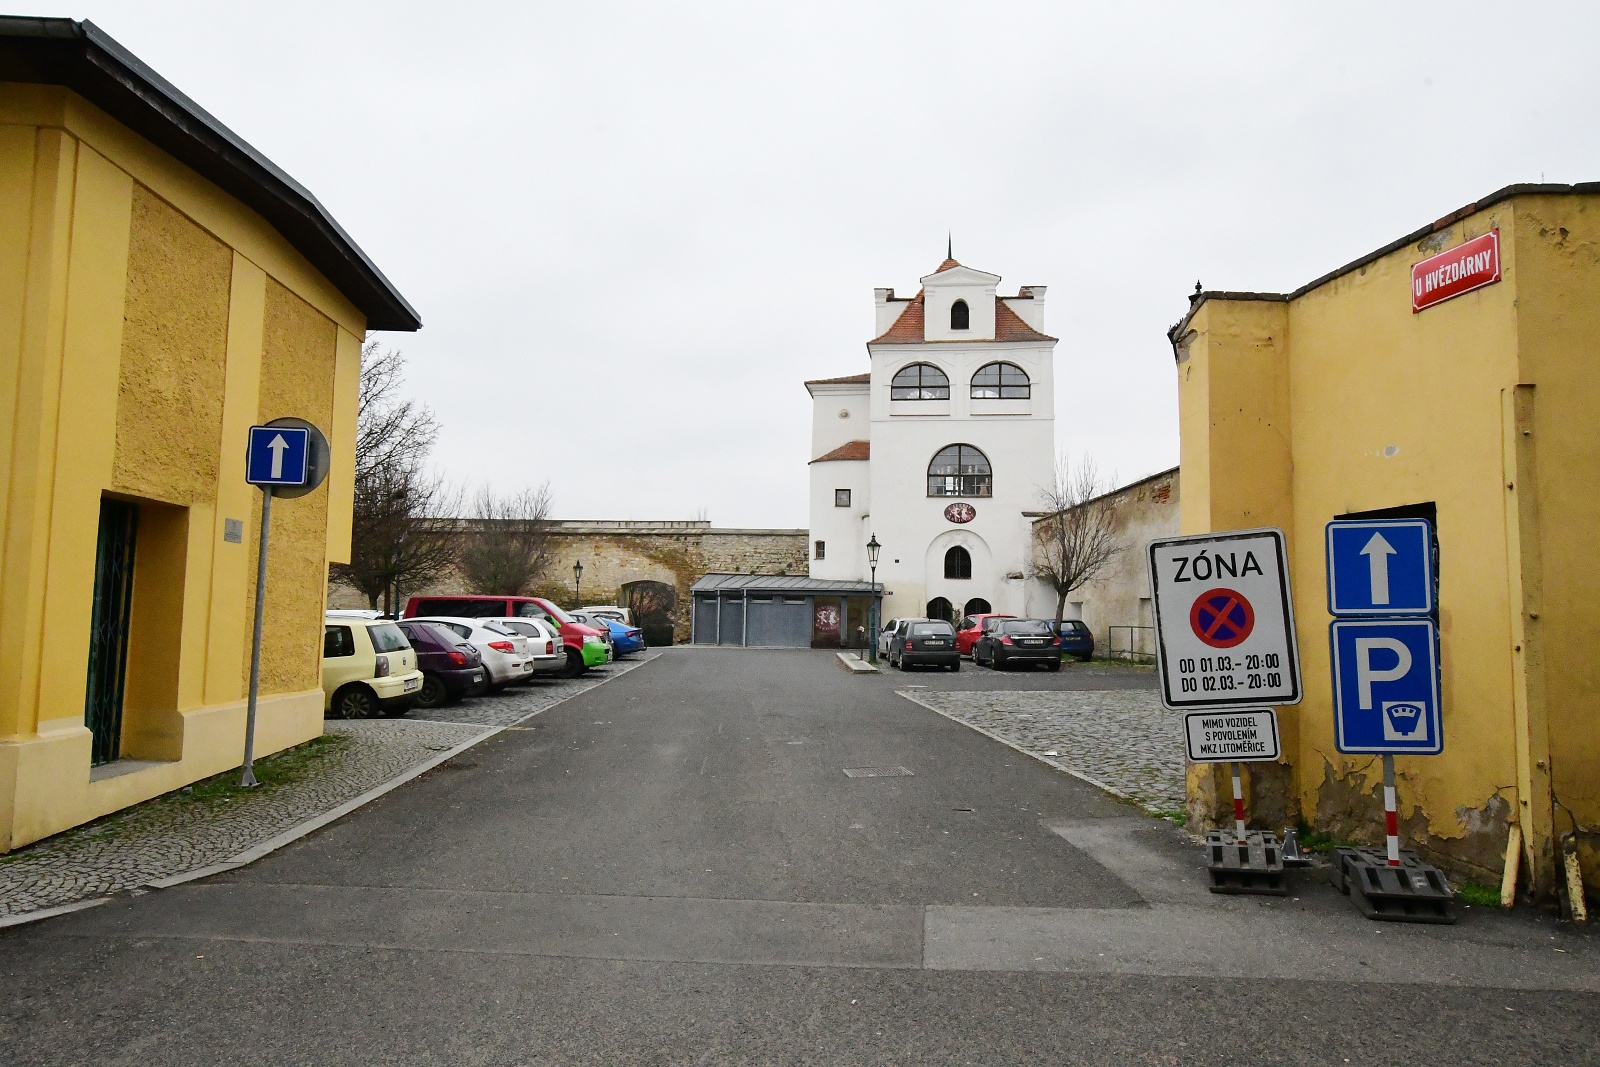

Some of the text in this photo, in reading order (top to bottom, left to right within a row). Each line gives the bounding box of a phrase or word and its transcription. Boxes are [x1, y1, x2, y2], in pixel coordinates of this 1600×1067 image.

[1415, 249, 1492, 297] U HVĚZDÁRNY
[1172, 549, 1264, 583] ZÓNA
[1179, 658, 1196, 674] OD
[1245, 653, 1280, 669] 20:00
[1355, 637, 1412, 710] P
[1181, 677, 1198, 693] DO
[1247, 672, 1282, 689] 20:00
[1202, 716, 1258, 729] MIMO VOZIDEL
[1205, 727, 1257, 741] S POVOLENÍM
[1200, 740, 1266, 754] MKZ LITOMĚŘICE
